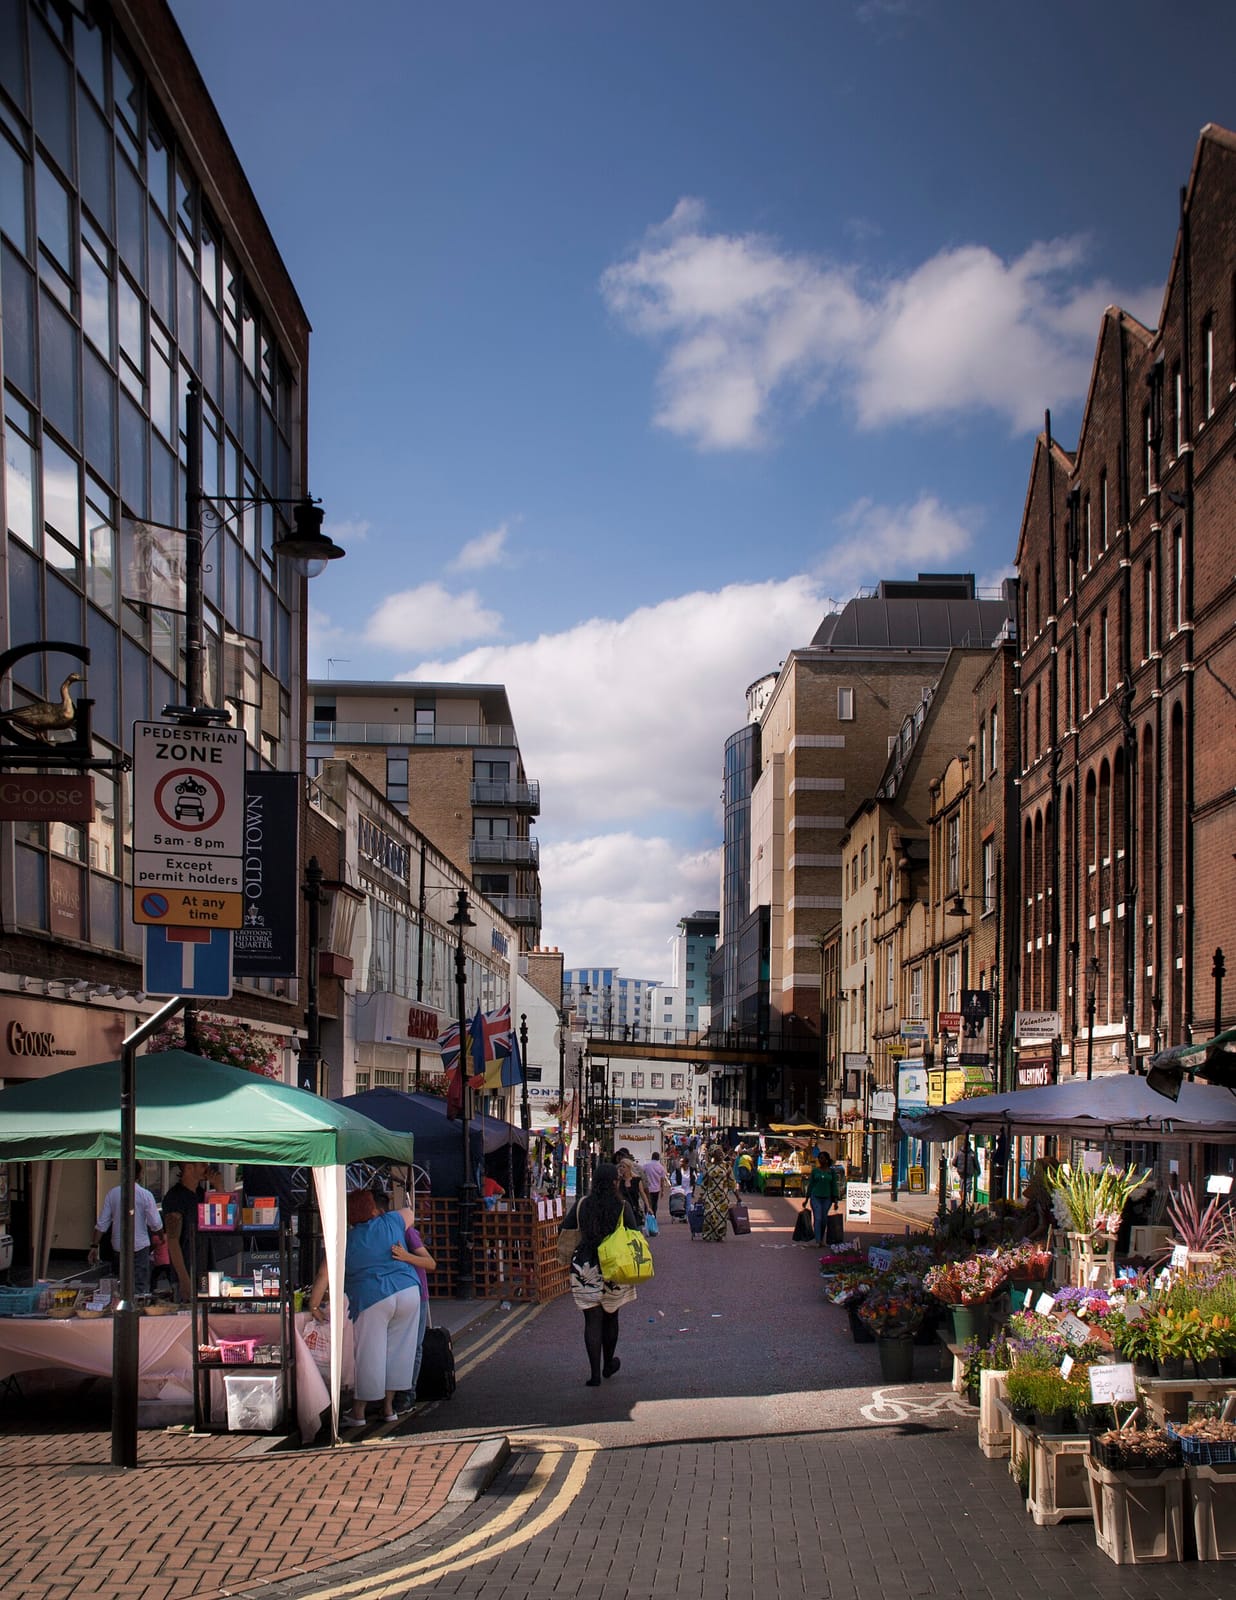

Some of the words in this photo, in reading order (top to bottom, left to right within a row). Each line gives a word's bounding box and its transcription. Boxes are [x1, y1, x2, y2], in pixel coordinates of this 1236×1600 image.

[143, 727, 237, 744] PEDESTRIAN
[156, 743, 222, 764] ZONE
[0, 783, 83, 805] Goose
[246, 794, 263, 854] TOWN
[166, 858, 213, 872] Except
[139, 871, 184, 882] permit
[188, 872, 238, 886] holders
[245, 857, 262, 899] OLD
[182, 896, 198, 906] At
[202, 899, 226, 910] any
[189, 909, 218, 921] time
[234, 941, 272, 949] QUARTER
[1019, 1013, 1055, 1026] Valentino's
[7, 1020, 56, 1057] Goose
[852, 1199, 866, 1208] SHOP
